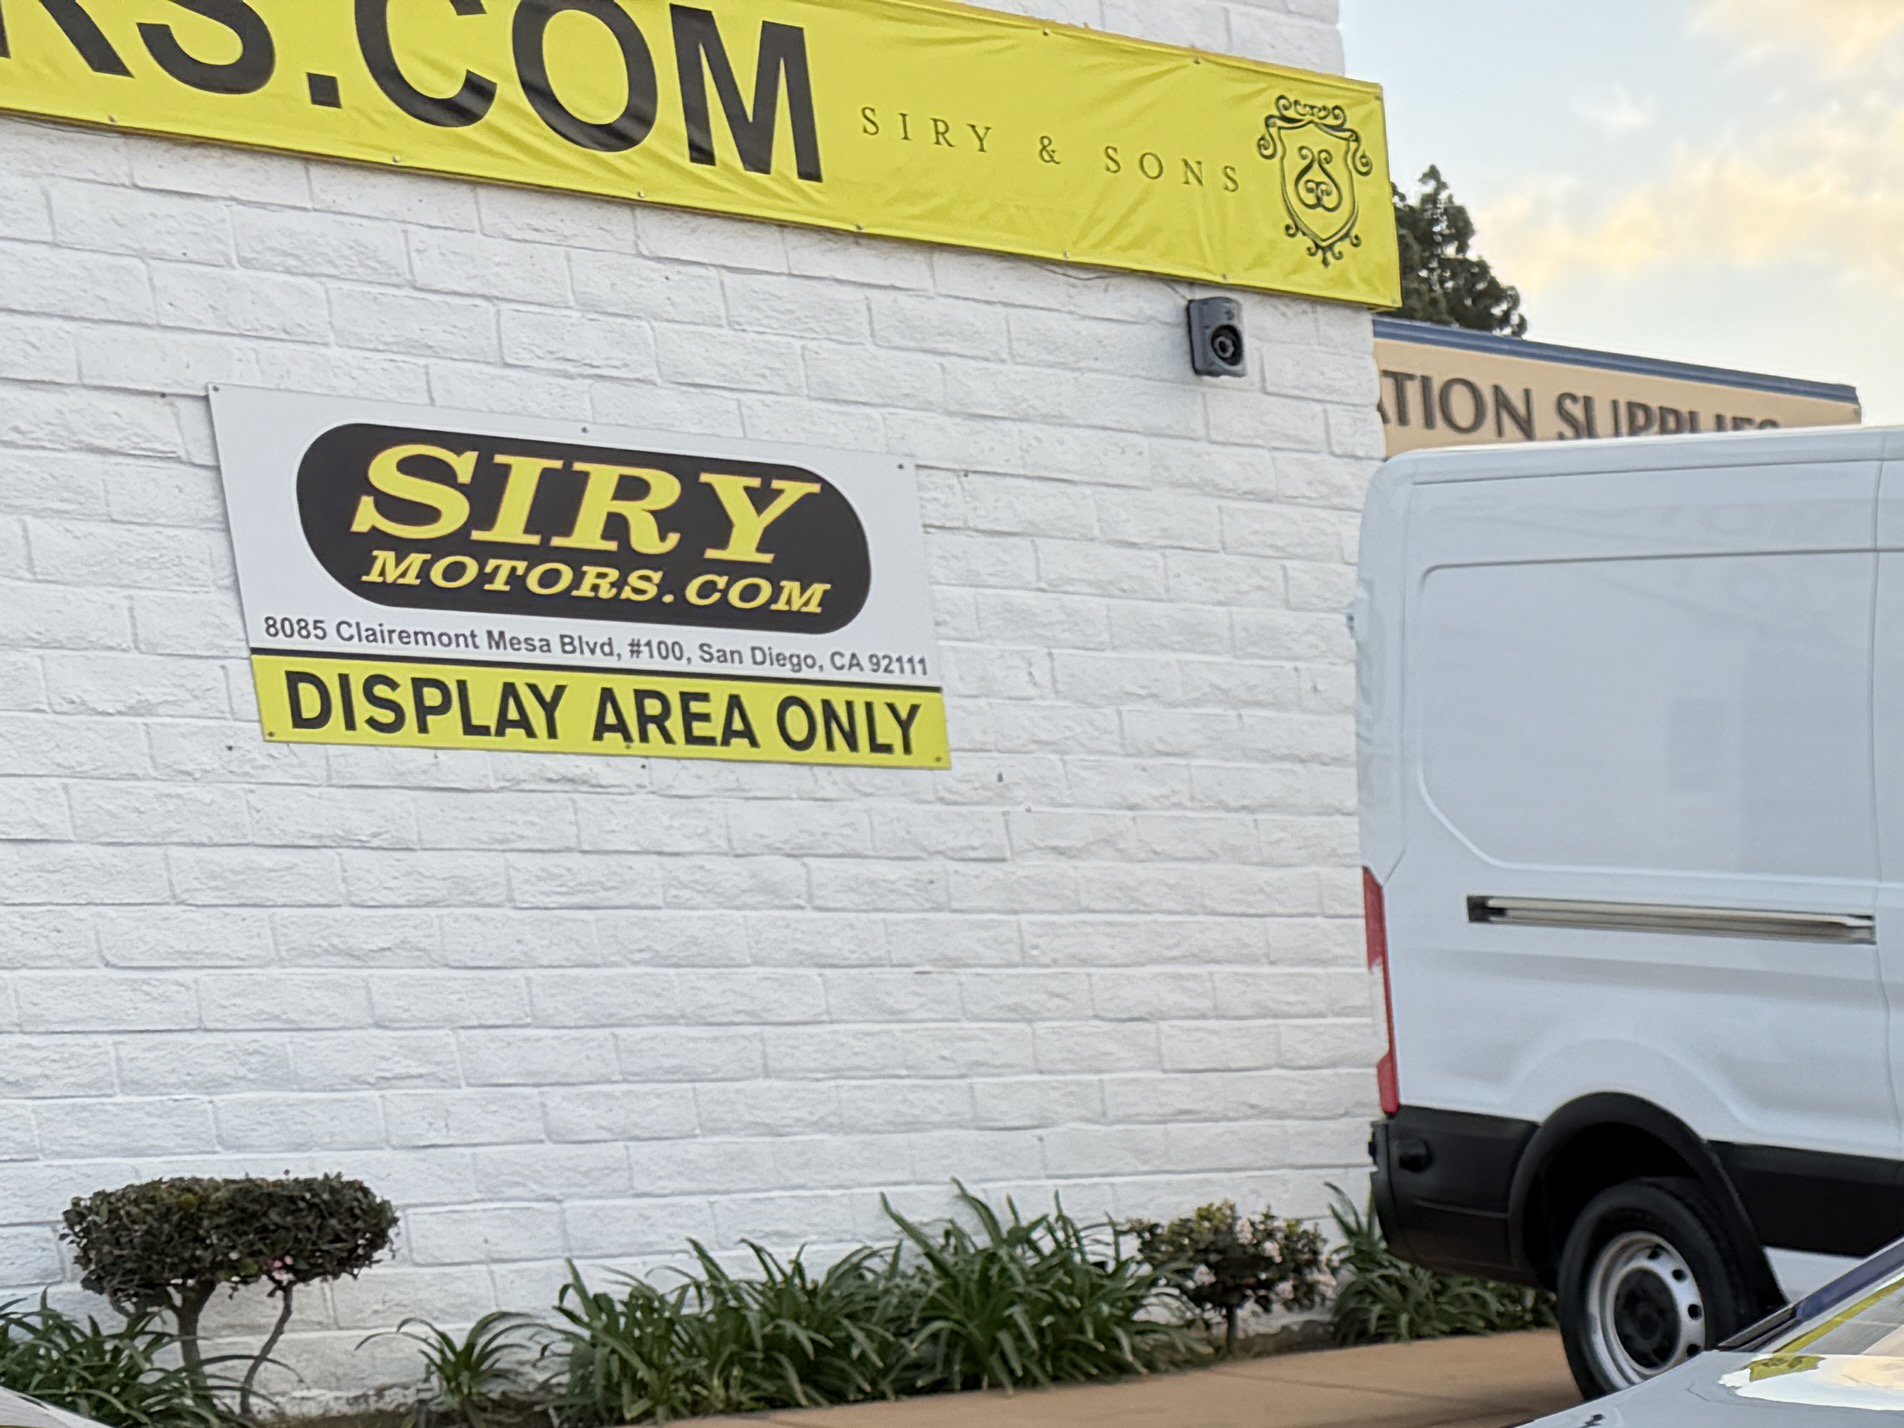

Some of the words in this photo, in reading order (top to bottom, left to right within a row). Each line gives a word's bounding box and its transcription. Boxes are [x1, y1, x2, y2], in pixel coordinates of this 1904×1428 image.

[860, 106, 993, 154] SIRY
[1037, 134, 1063, 166] &
[1104, 144, 1241, 193] SONS
[1377, 369, 1536, 441] TION
[350, 443, 822, 566] SIRY
[361, 550, 831, 614] MOTORS.COM
[263, 615, 328, 642] 8085
[335, 618, 479, 651] Clairemont
[487, 628, 553, 656] Mesa
[560, 633, 623, 662] Blvd,
[627, 638, 694, 666] #100,
[699, 642, 745, 667] San
[751, 646, 826, 676] Diego,
[829, 649, 865, 674] CA
[869, 651, 929, 678] 92111
[284, 670, 568, 742] DISPLAY
[592, 686, 761, 751] AREA
[776, 696, 922, 757] ONLY
